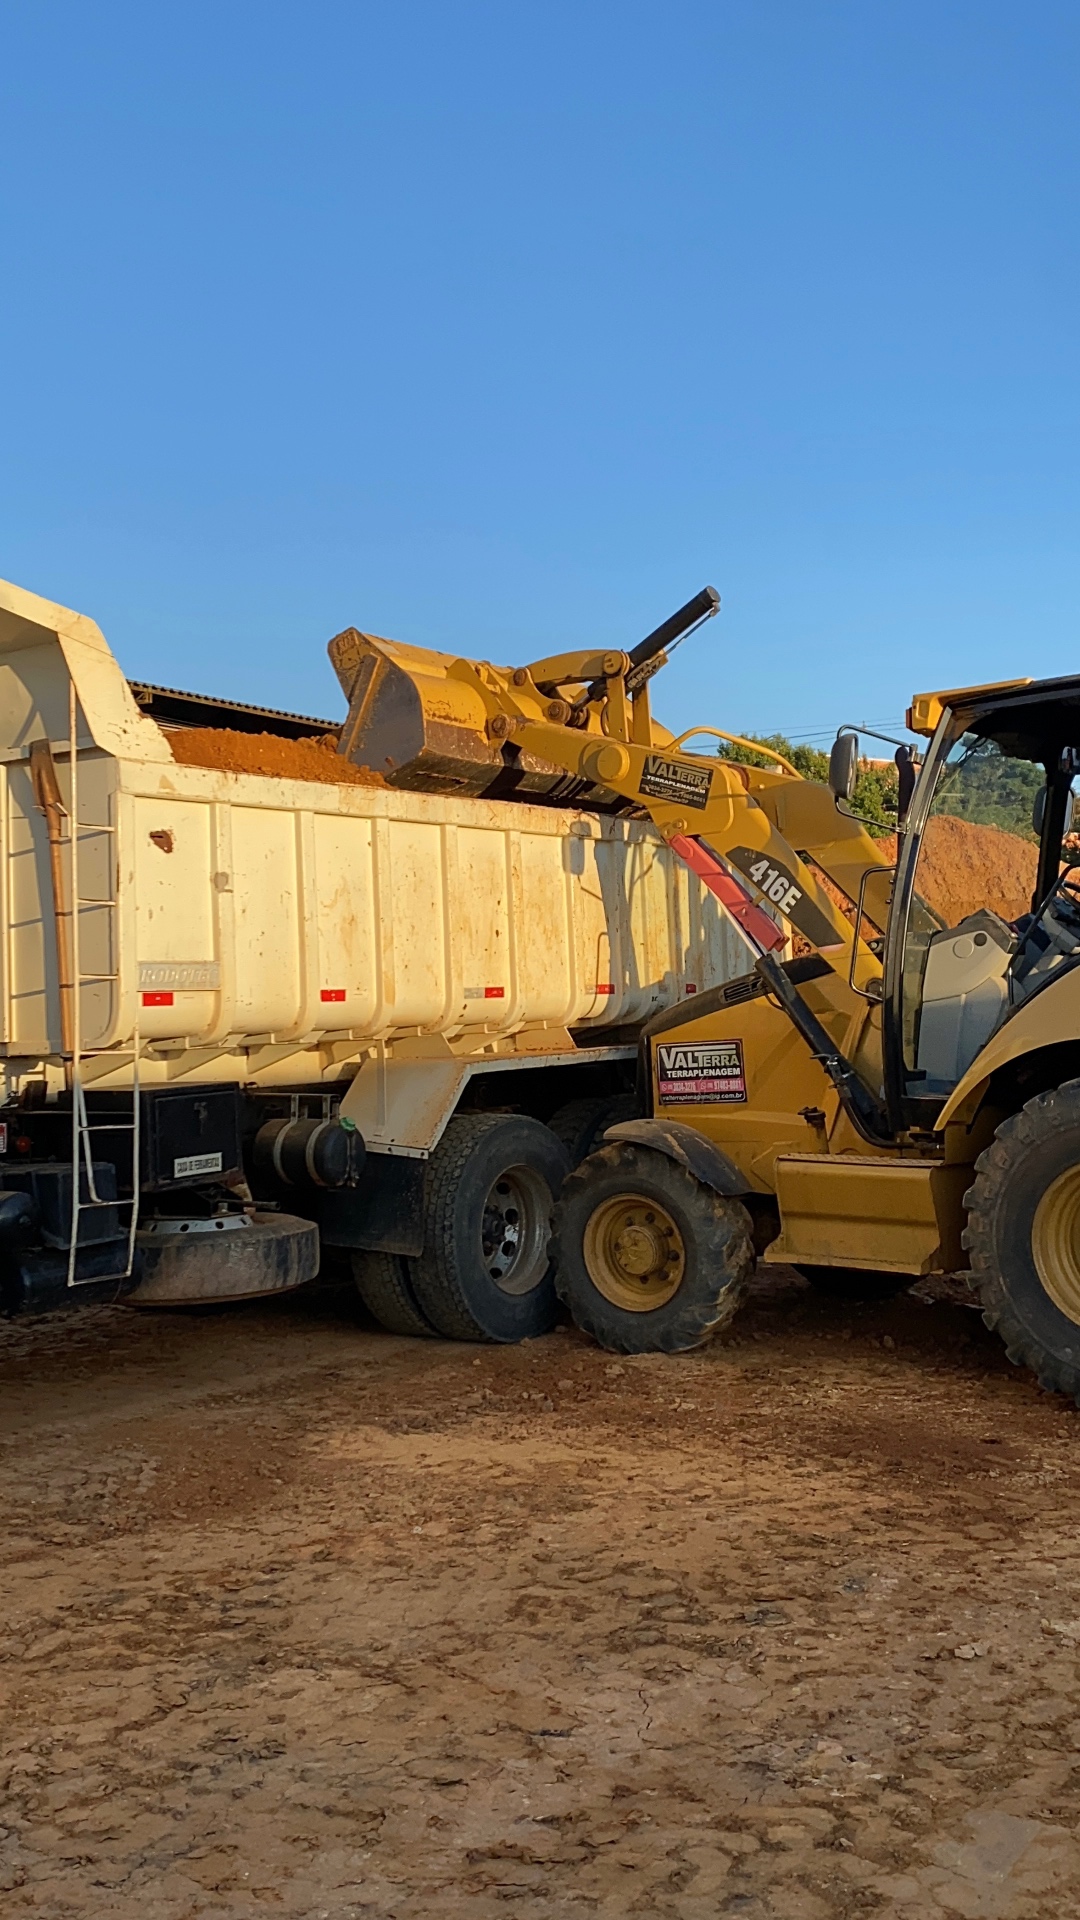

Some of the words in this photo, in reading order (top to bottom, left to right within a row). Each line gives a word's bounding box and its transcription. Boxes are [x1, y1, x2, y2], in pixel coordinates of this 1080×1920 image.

[646, 774, 706, 794] TERRAPLENAGEM
[648, 756, 710, 787] VALTERRA
[749, 859, 802, 915] 416E
[660, 1044, 740, 1069] VALTERRA
[667, 1067, 740, 1078] TERRAPLENAGEM
